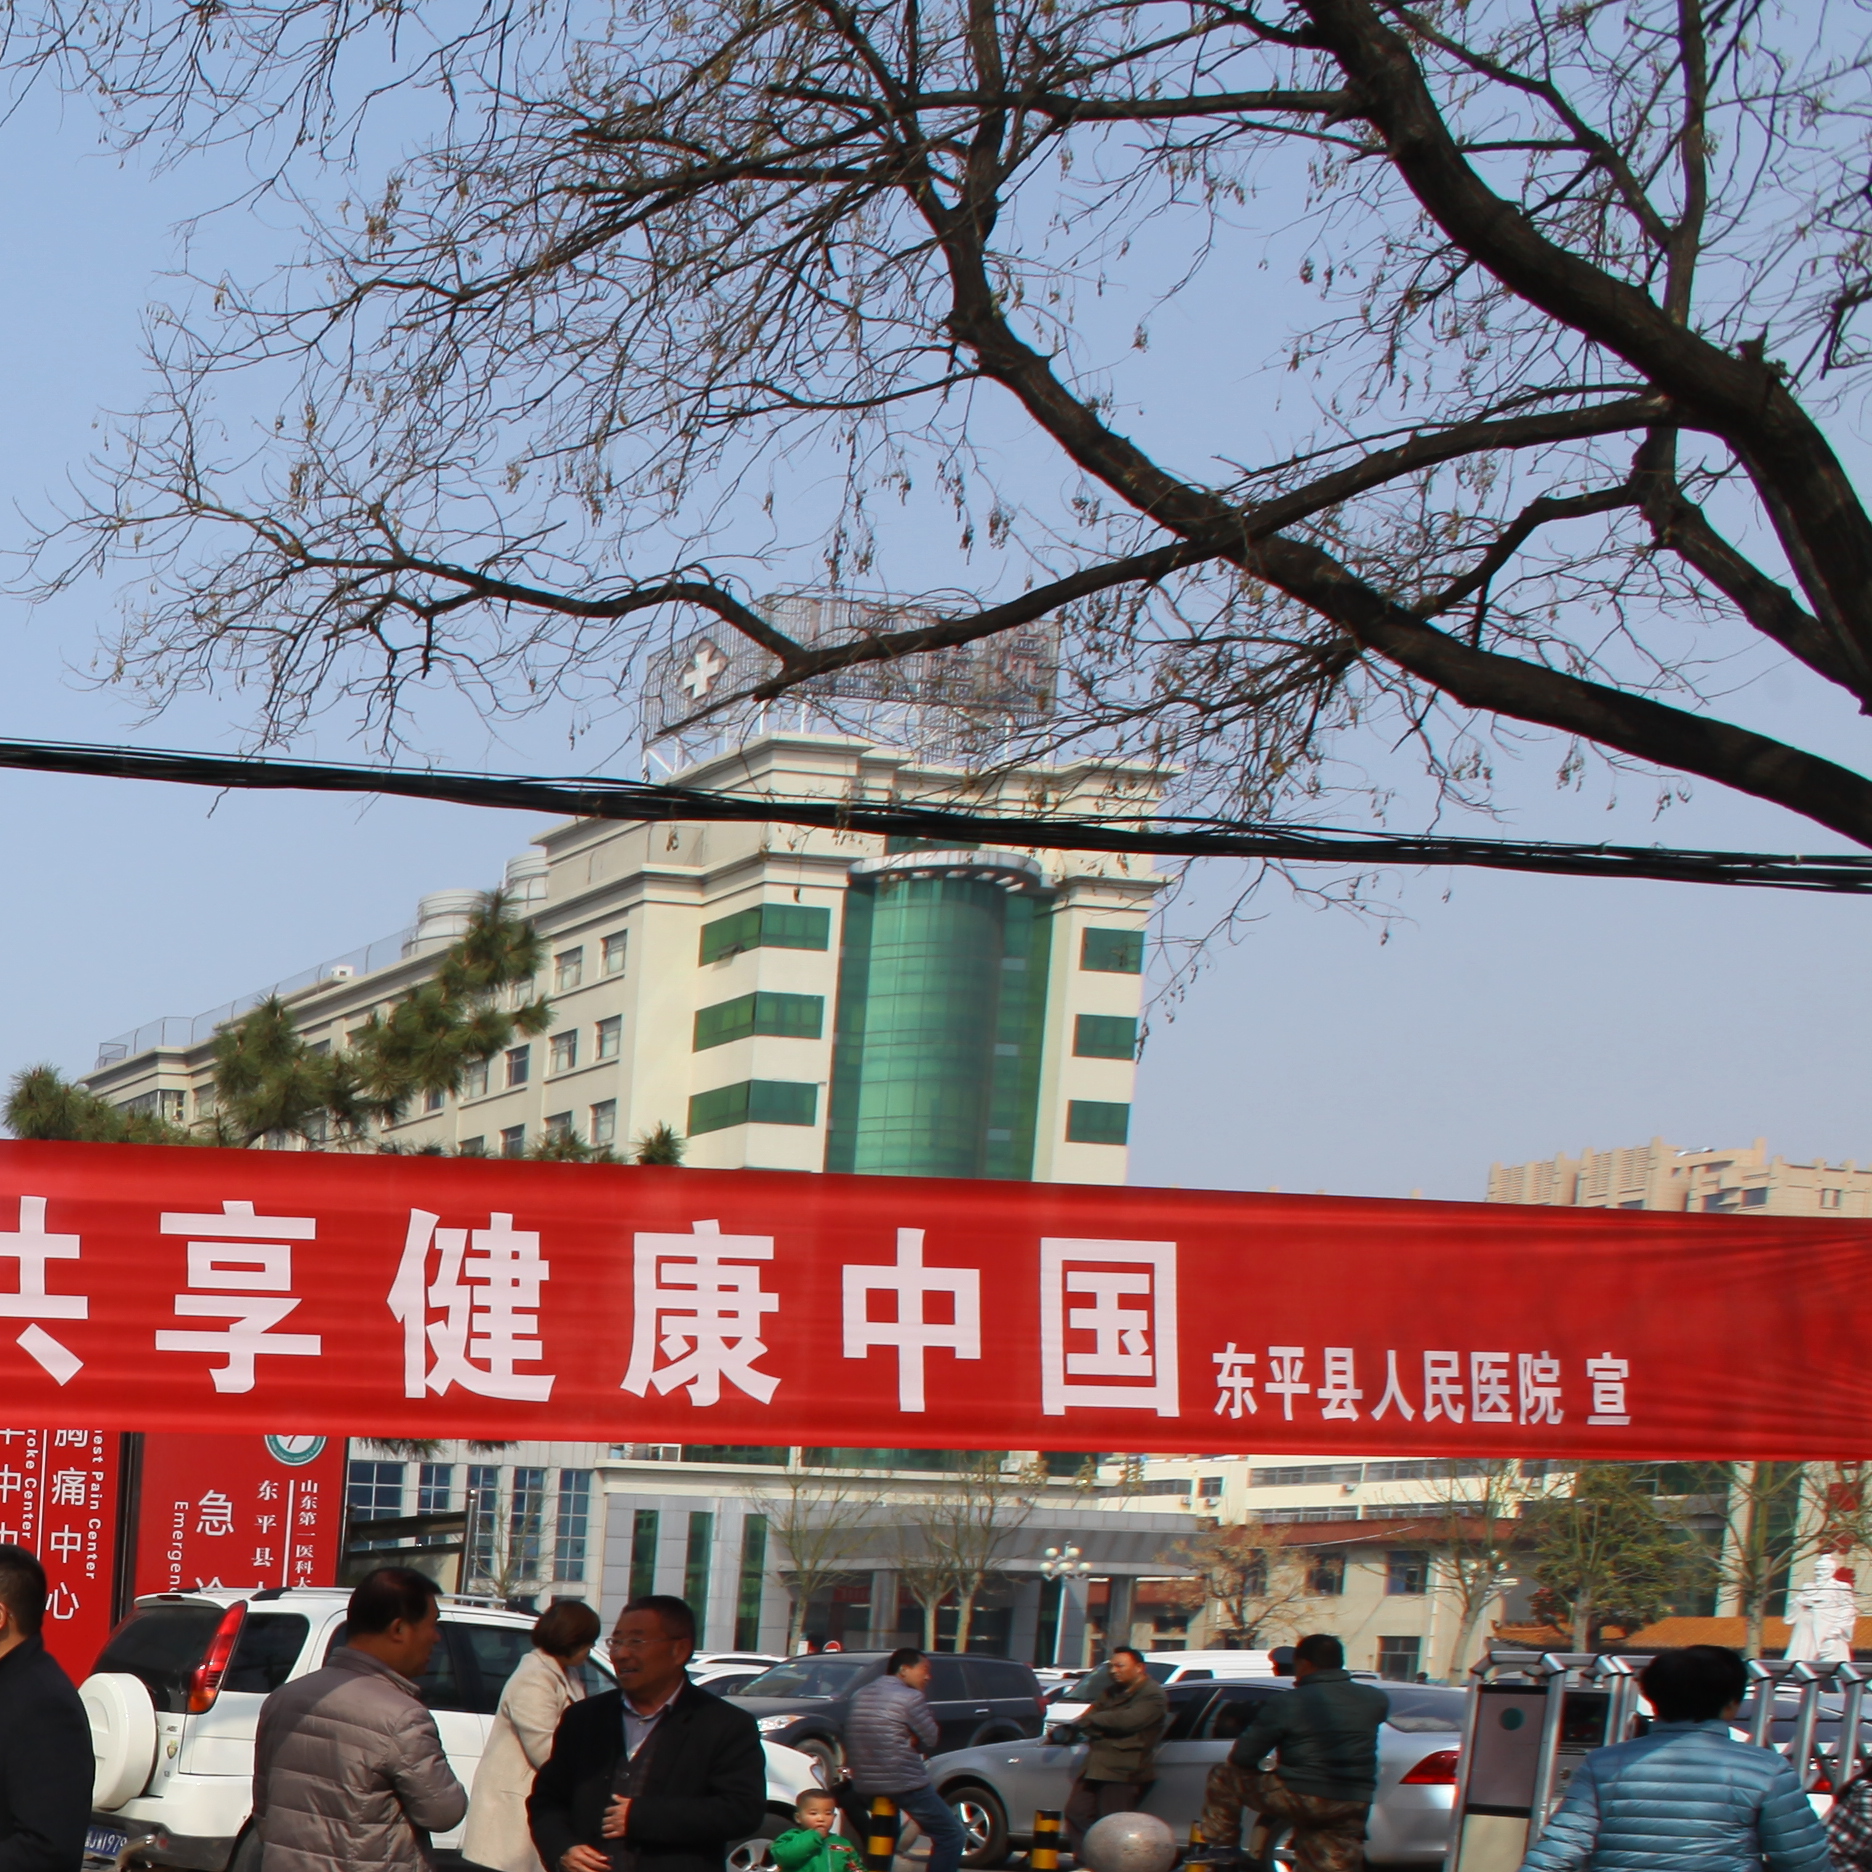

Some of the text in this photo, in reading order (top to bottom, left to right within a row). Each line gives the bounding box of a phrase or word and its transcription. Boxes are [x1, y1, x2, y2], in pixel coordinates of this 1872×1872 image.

[1213, 1341, 1631, 1426] 东平县人民医院 宣
[22, 1478, 37, 1539] Center
[89, 1471, 104, 1510] Pain
[85, 1518, 101, 1579] Center
[167, 1501, 189, 1592] Emergen
